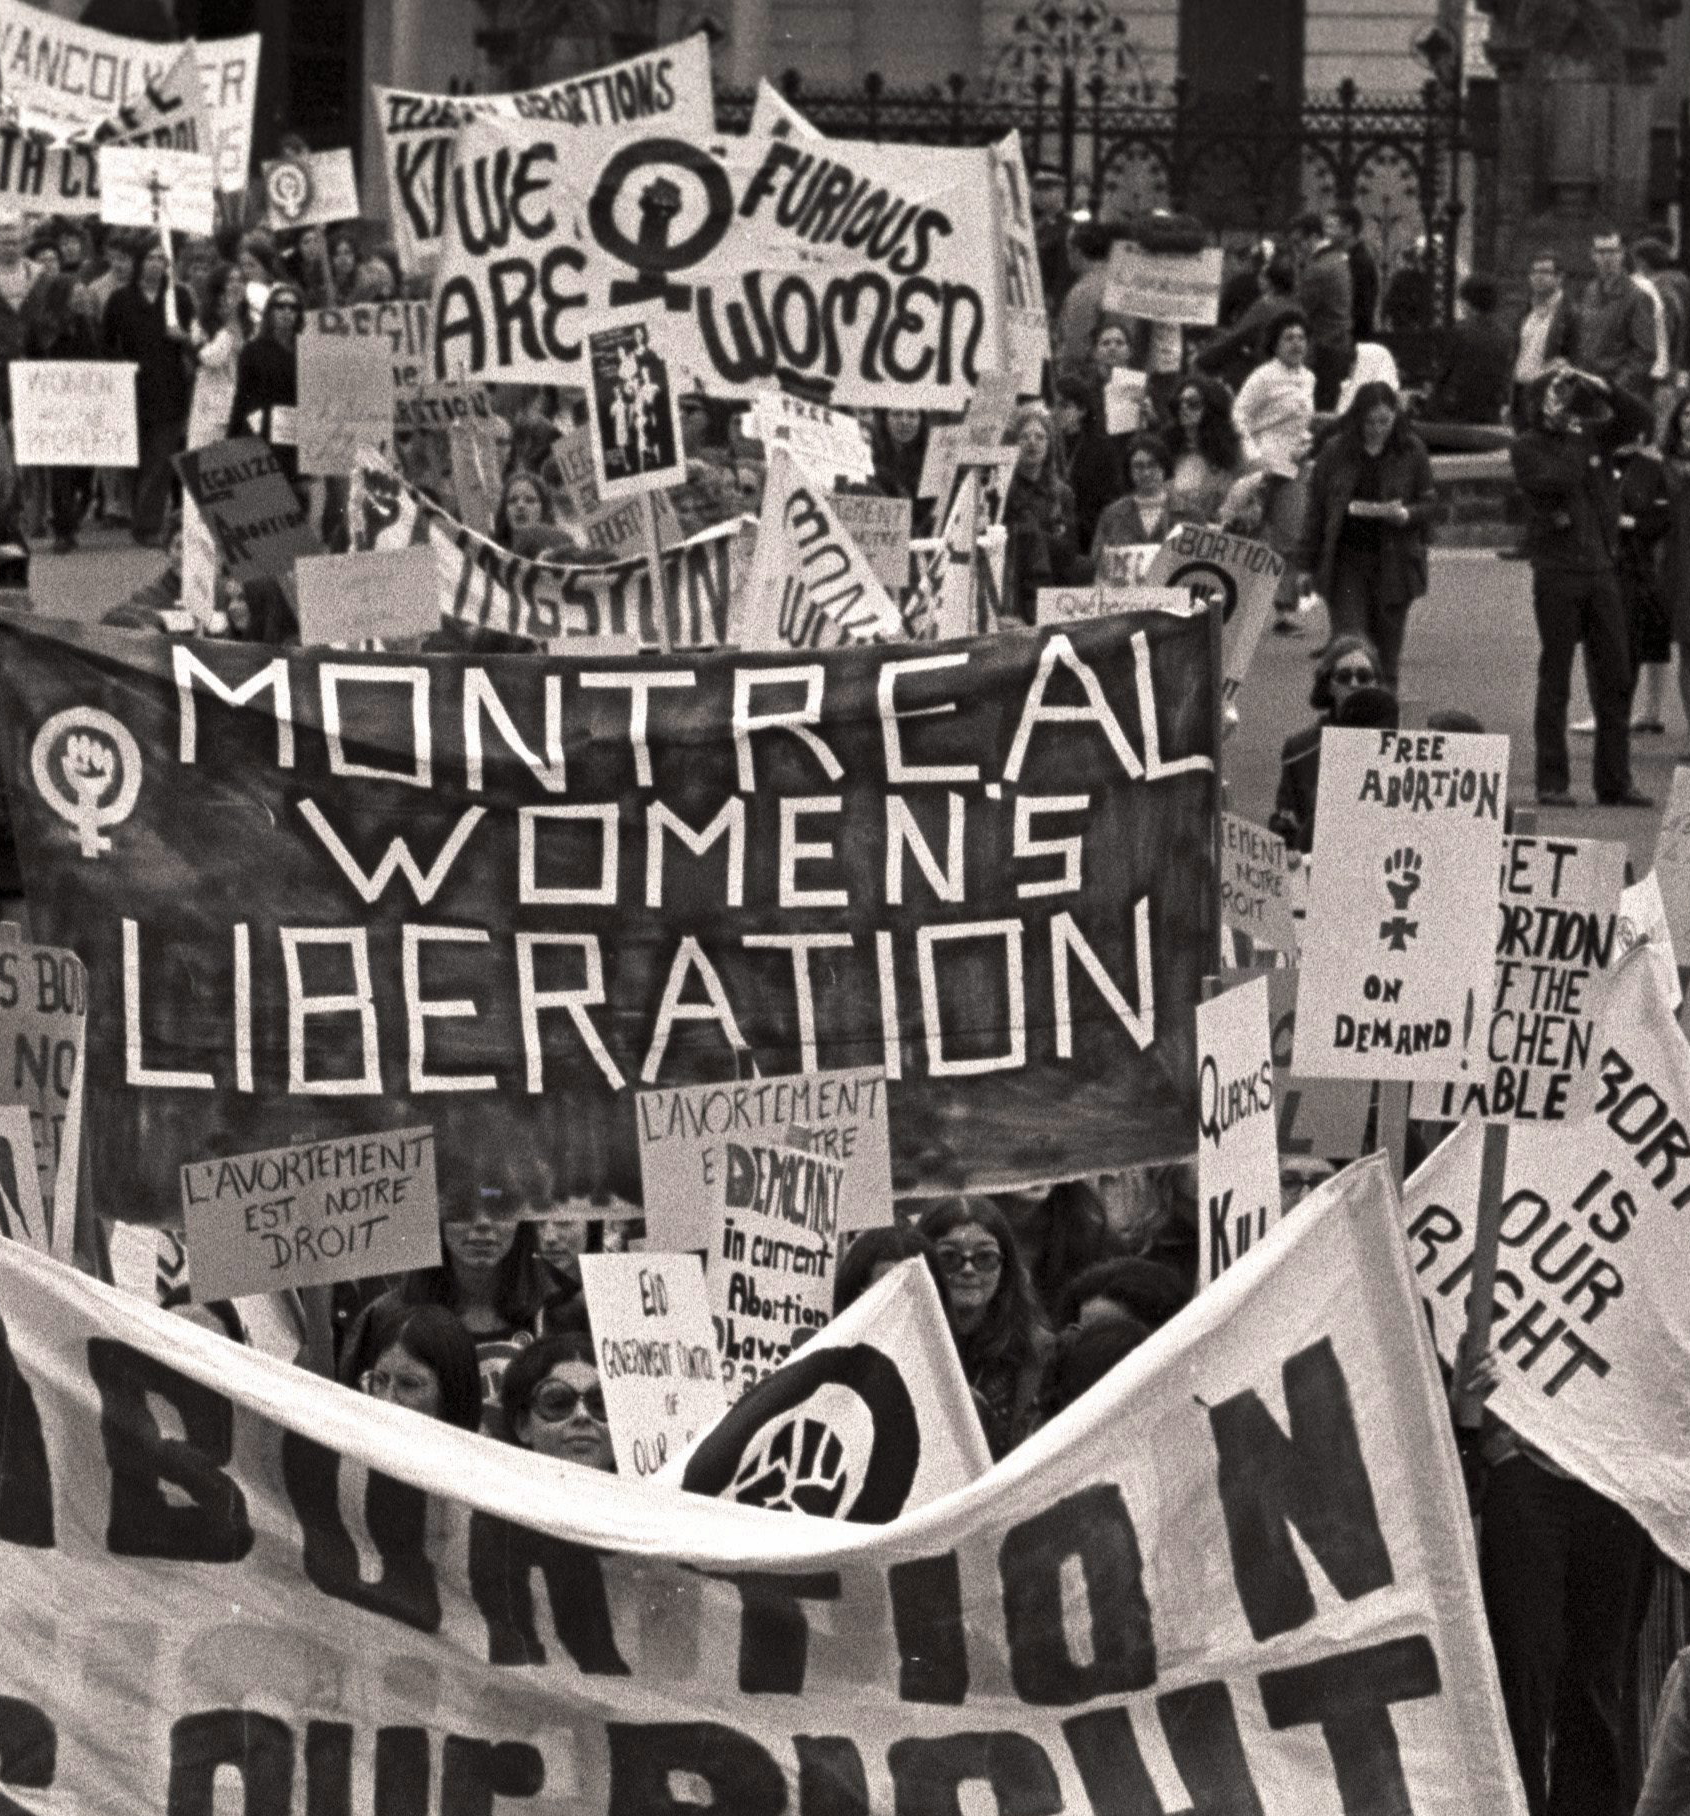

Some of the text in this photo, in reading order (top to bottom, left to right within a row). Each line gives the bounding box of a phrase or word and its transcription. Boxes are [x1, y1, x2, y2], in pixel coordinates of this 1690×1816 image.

[454, 142, 557, 256] WE
[738, 141, 954, 276] FURIOUS
[434, 245, 588, 381] ARE
[695, 269, 985, 387] WOMEN
[453, 529, 731, 646] INGSTON
[172, 630, 1214, 792] MONTREAL
[1379, 730, 1445, 763] FREE
[296, 782, 1090, 908] WOMEN'S
[1501, 837, 1578, 899] ET
[1222, 880, 1266, 921] ROIT
[121, 896, 1155, 1096] LIBERATION
[1364, 974, 1404, 1003] ON
[1531, 965, 1590, 1015] THE
[640, 1074, 887, 1142] L'AVORTEMENT
[184, 1133, 434, 1205] L'AVORTEMENT
[244, 1176, 413, 1233] EST NOTRE
[1571, 1168, 1638, 1244] IS
[260, 1214, 390, 1270] DROIT
[723, 1217, 834, 1278] in current
[1498, 1188, 1625, 1325] OUR
[638, 1268, 669, 1318] END
[728, 1271, 830, 1328] Abortion
